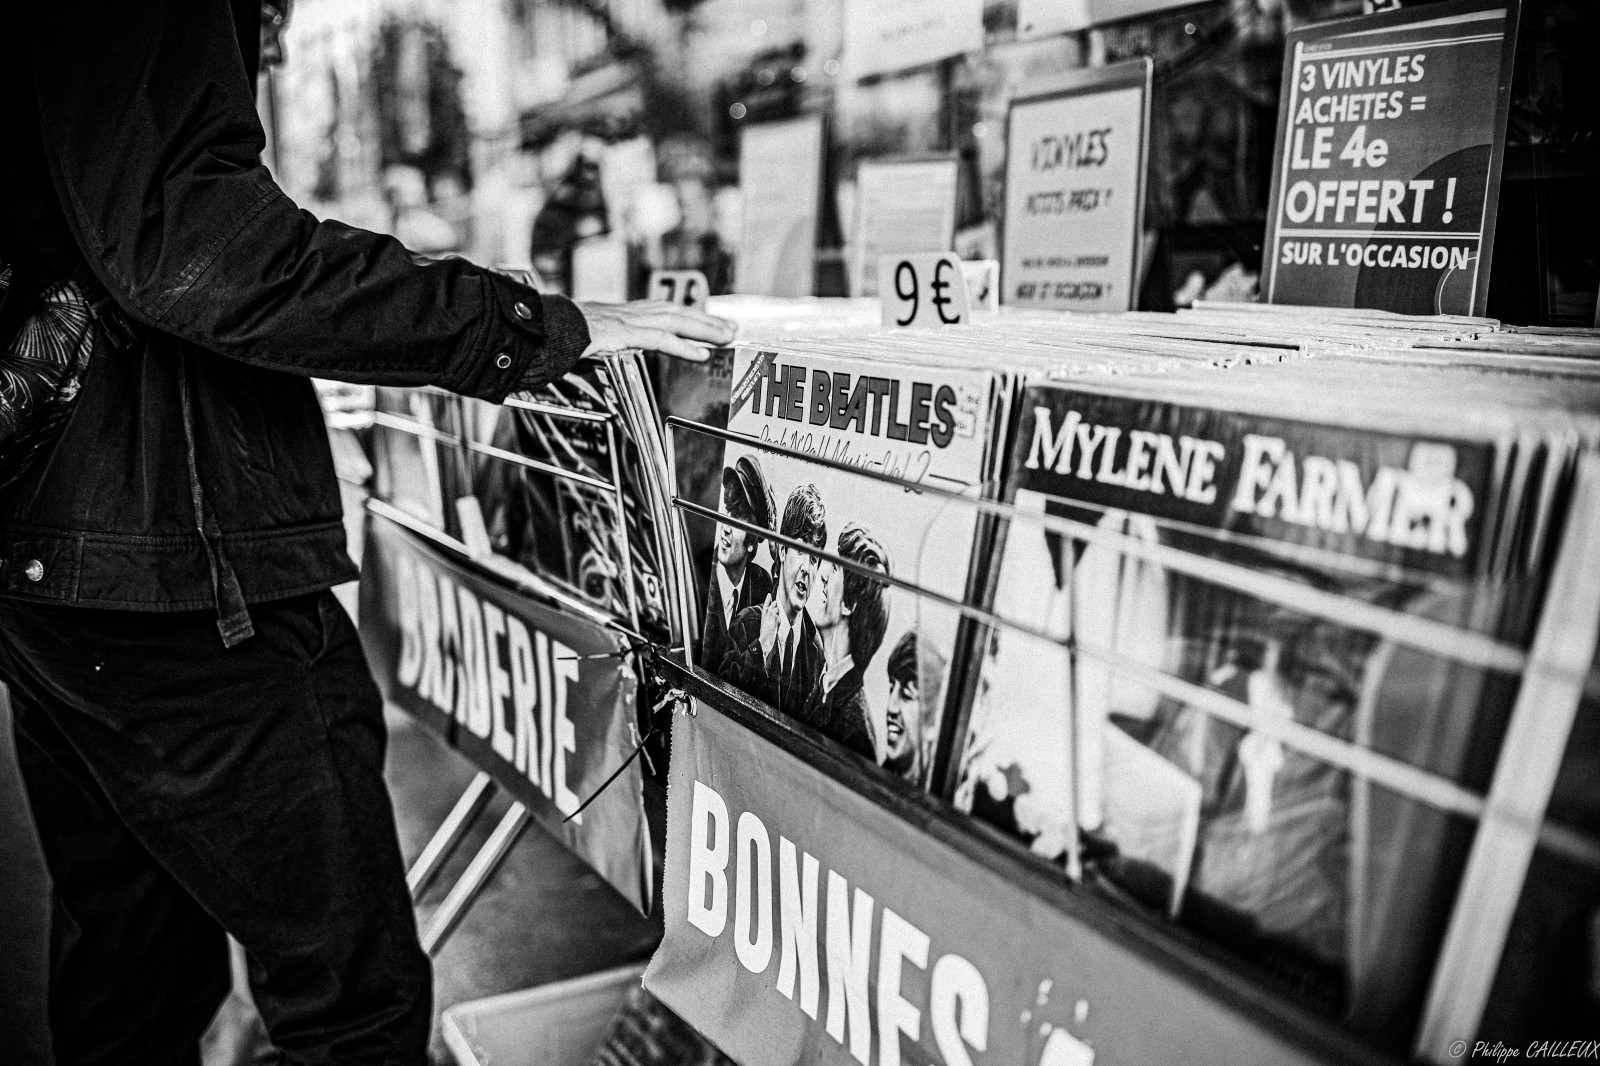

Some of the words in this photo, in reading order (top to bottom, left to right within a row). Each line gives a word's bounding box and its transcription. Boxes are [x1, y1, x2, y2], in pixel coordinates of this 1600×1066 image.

[1300, 64, 1316, 92] 3
[1321, 53, 1426, 90] VINYLES
[1295, 90, 1404, 125] ACHETES
[1291, 127, 1334, 170] LE
[1339, 124, 1389, 168] 4e
[1285, 180, 1434, 223] OFFERT
[1281, 241, 1322, 265] SUR
[1327, 242, 1470, 270] L'OCCASION
[751, 360, 807, 423] THE
[809, 369, 957, 449] BEATLES
[1025, 406, 1225, 505] MYLENE
[688, 779, 989, 1066] BONNES
